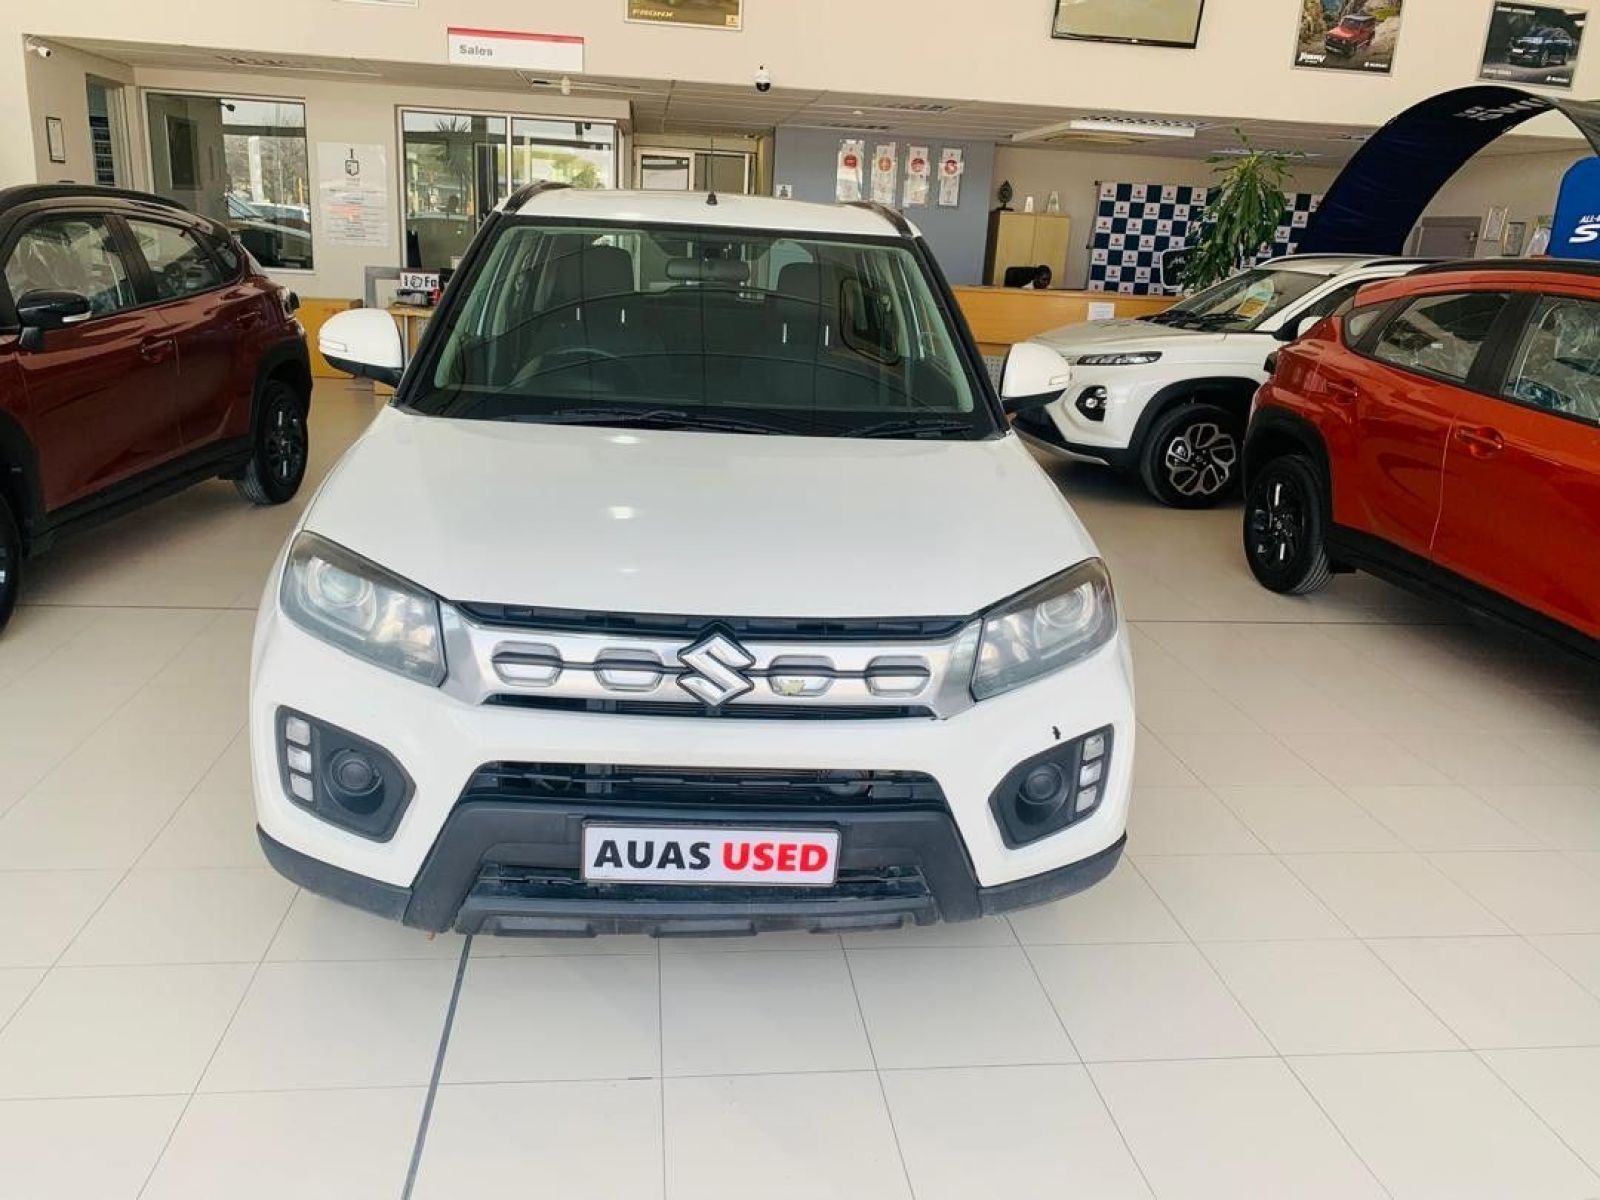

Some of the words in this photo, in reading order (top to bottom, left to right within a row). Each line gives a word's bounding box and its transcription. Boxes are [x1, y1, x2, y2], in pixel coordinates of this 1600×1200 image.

[459, 44, 493, 57] Sales
[593, 840, 711, 870] AUAS
[722, 842, 828, 872] USED
